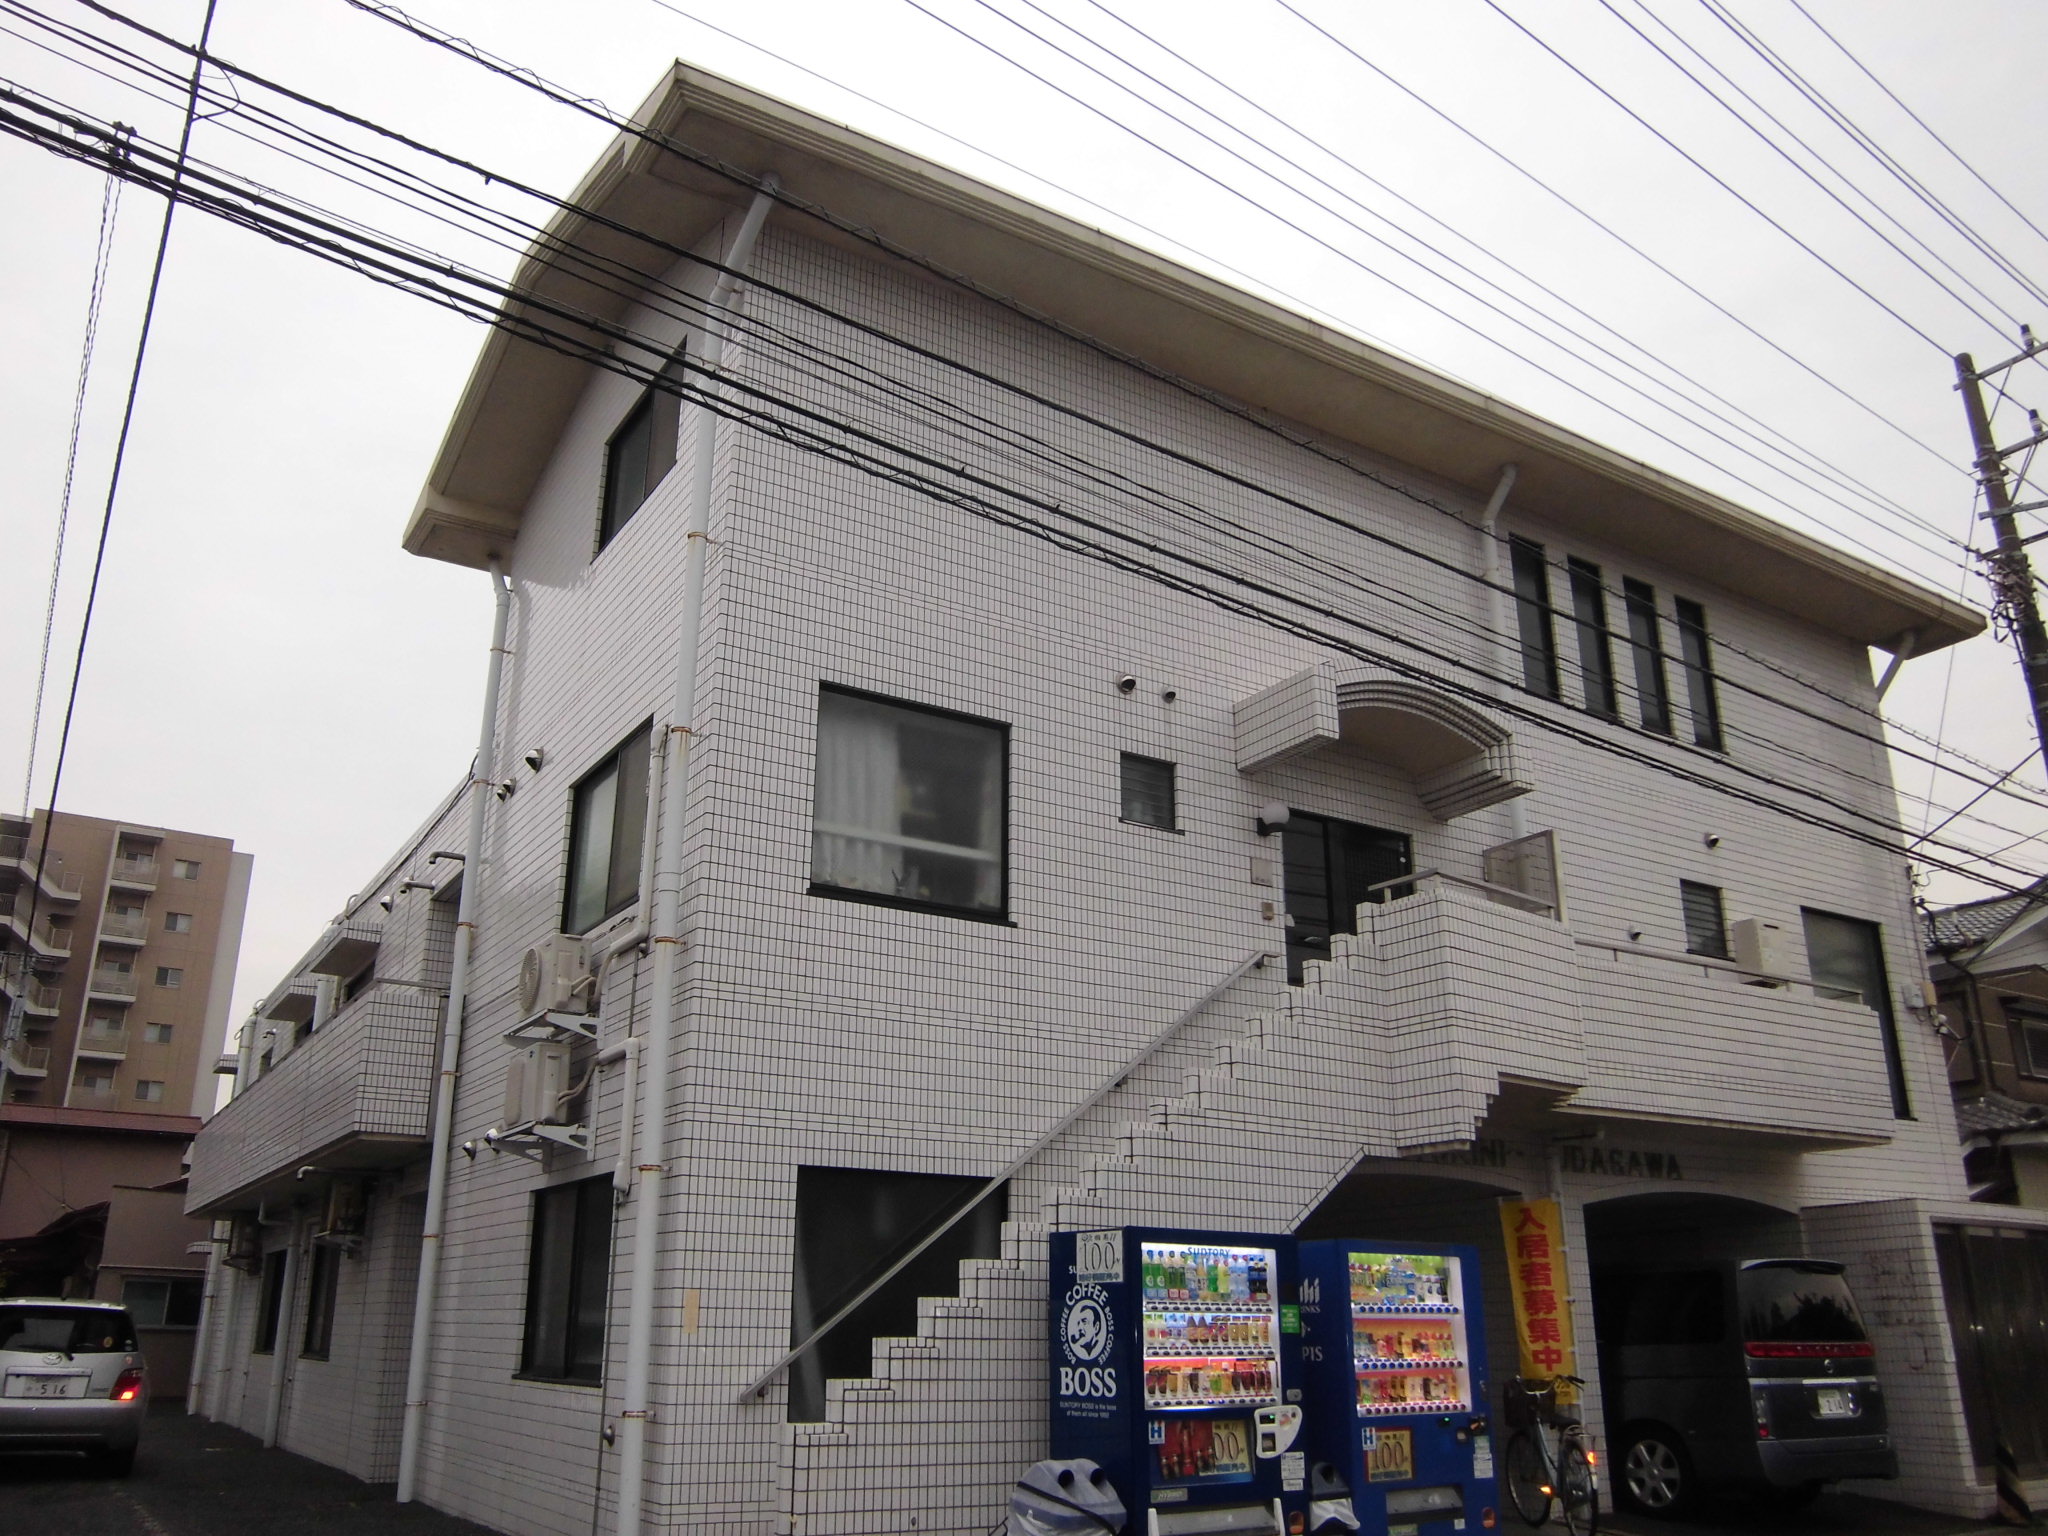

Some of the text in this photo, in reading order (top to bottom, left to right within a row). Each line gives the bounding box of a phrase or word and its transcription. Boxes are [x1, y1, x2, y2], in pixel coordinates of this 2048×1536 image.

[1187, 1246, 1230, 1257] SUNTORY
[1066, 1282, 1108, 1306] COFFEE
[1514, 1207, 1563, 1373] 入居者募集中
[1059, 1367, 1117, 1398] BOSS
